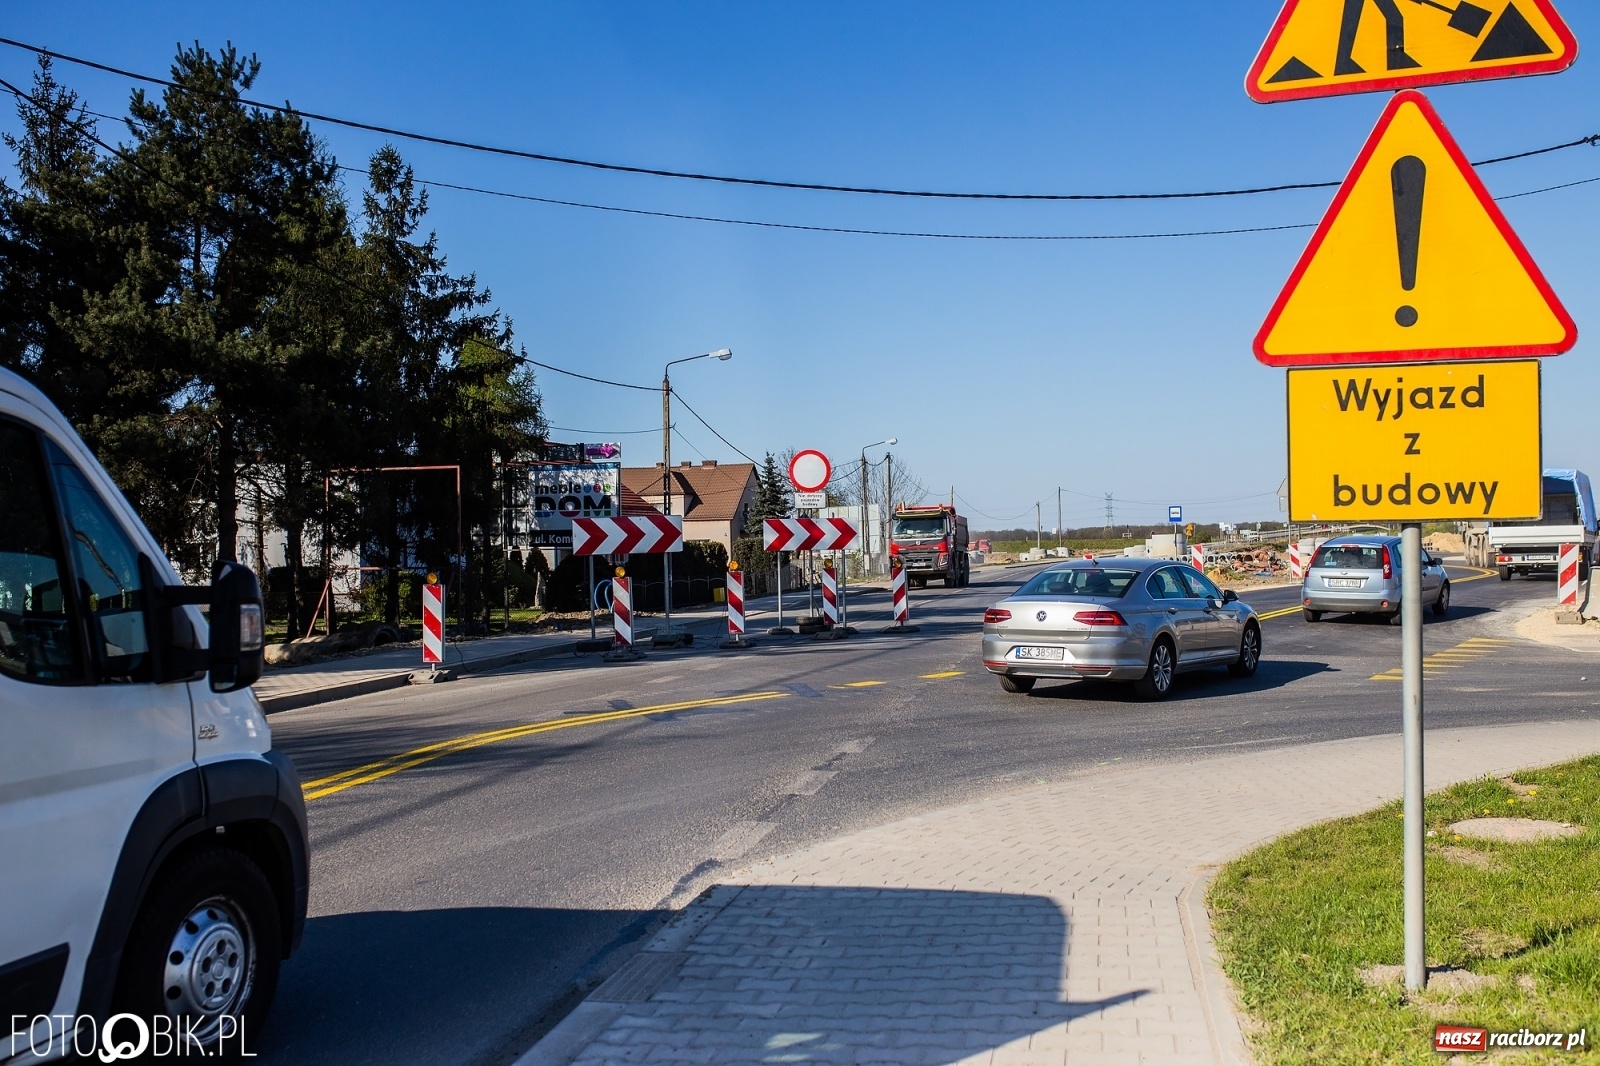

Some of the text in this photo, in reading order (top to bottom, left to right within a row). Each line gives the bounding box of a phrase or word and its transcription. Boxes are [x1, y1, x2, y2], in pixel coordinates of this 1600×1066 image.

[1332, 374, 1485, 421] Wyjazd
[1403, 432, 1421, 455] z
[535, 482, 581, 494] meble
[1333, 472, 1499, 514] budowy
[535, 495, 611, 517] DOM
[535, 534, 546, 543] ul.
[1021, 647, 1033, 657] SK
